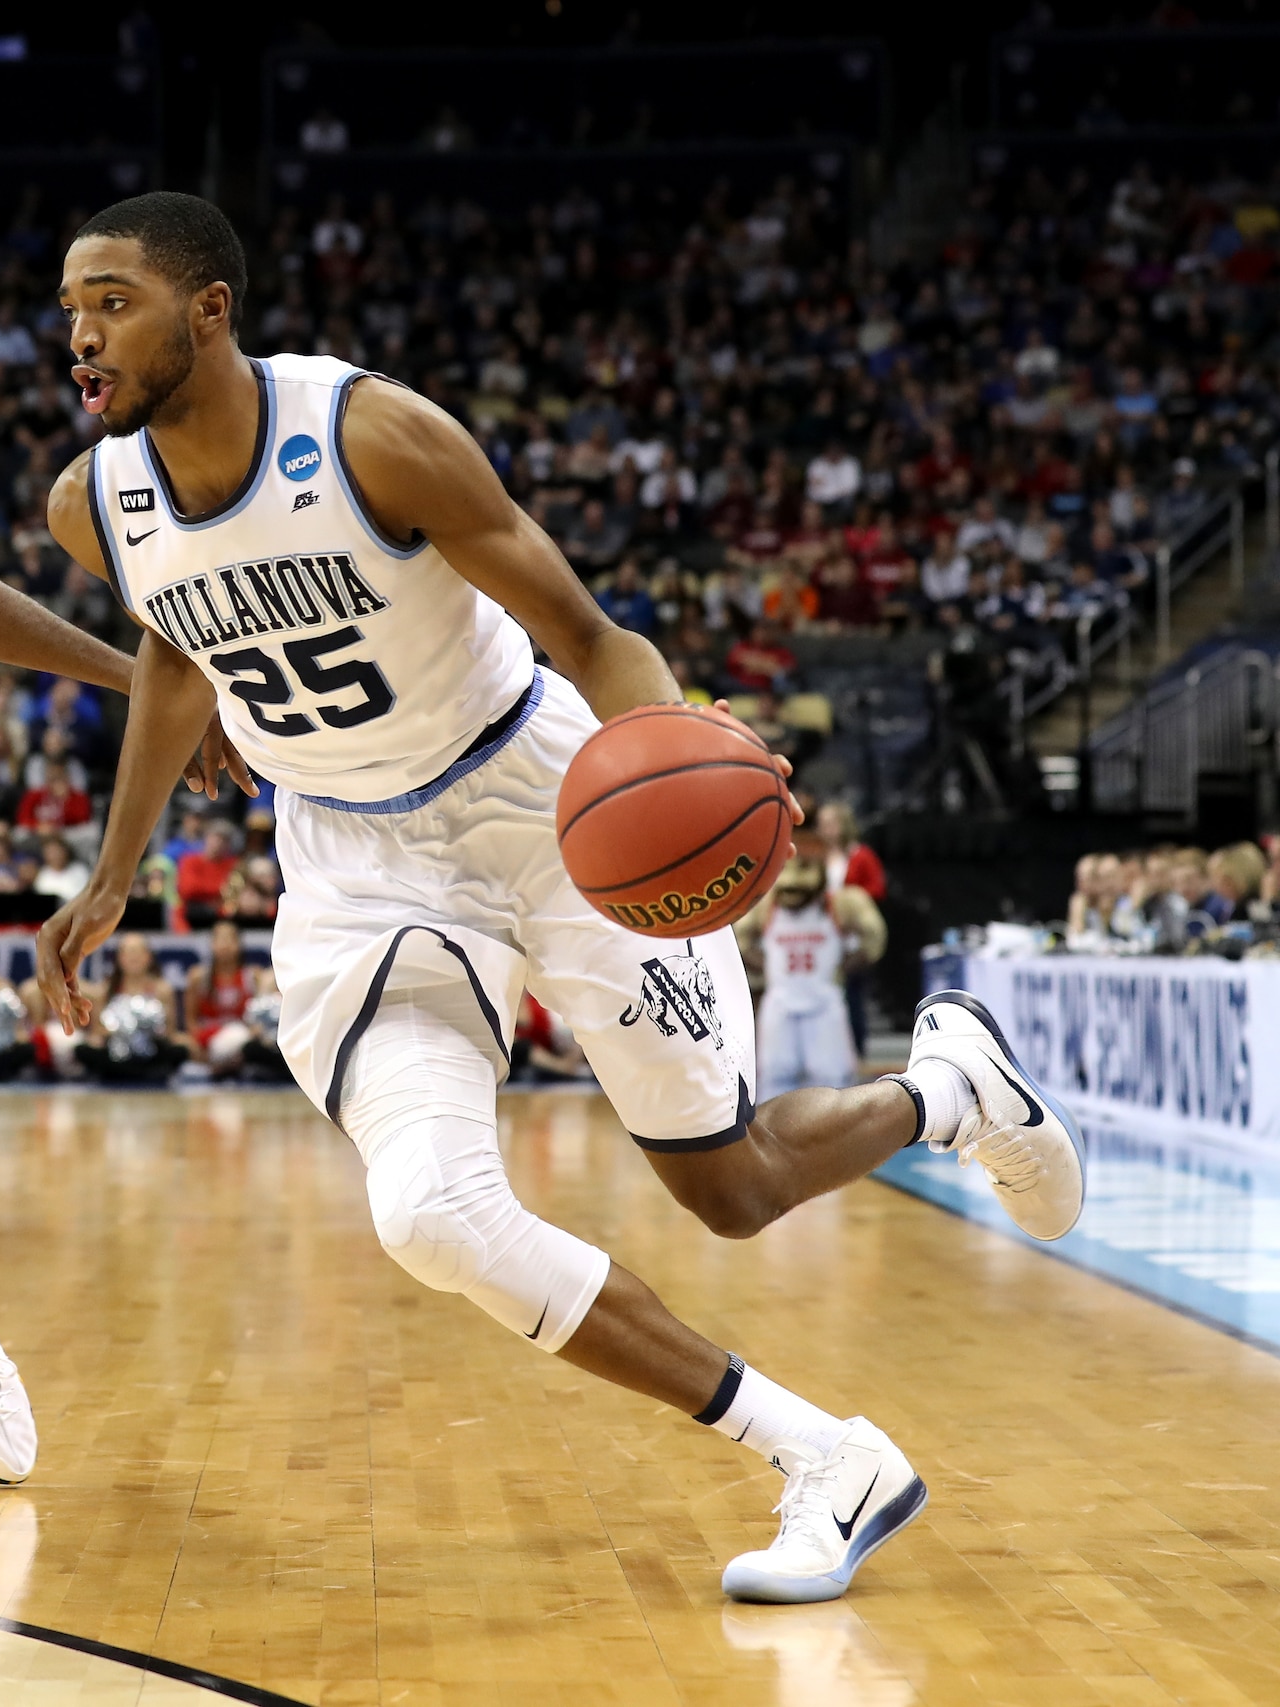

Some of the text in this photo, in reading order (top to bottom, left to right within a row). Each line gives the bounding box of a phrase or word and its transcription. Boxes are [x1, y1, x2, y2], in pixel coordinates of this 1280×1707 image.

[285, 450, 320, 473] NCAA
[121, 493, 149, 509] RVM
[144, 552, 391, 654] VILLANOVA
[209, 625, 397, 737] 25
[603, 854, 757, 928] Wilson
[652, 966, 702, 1034] VILLANOVA
